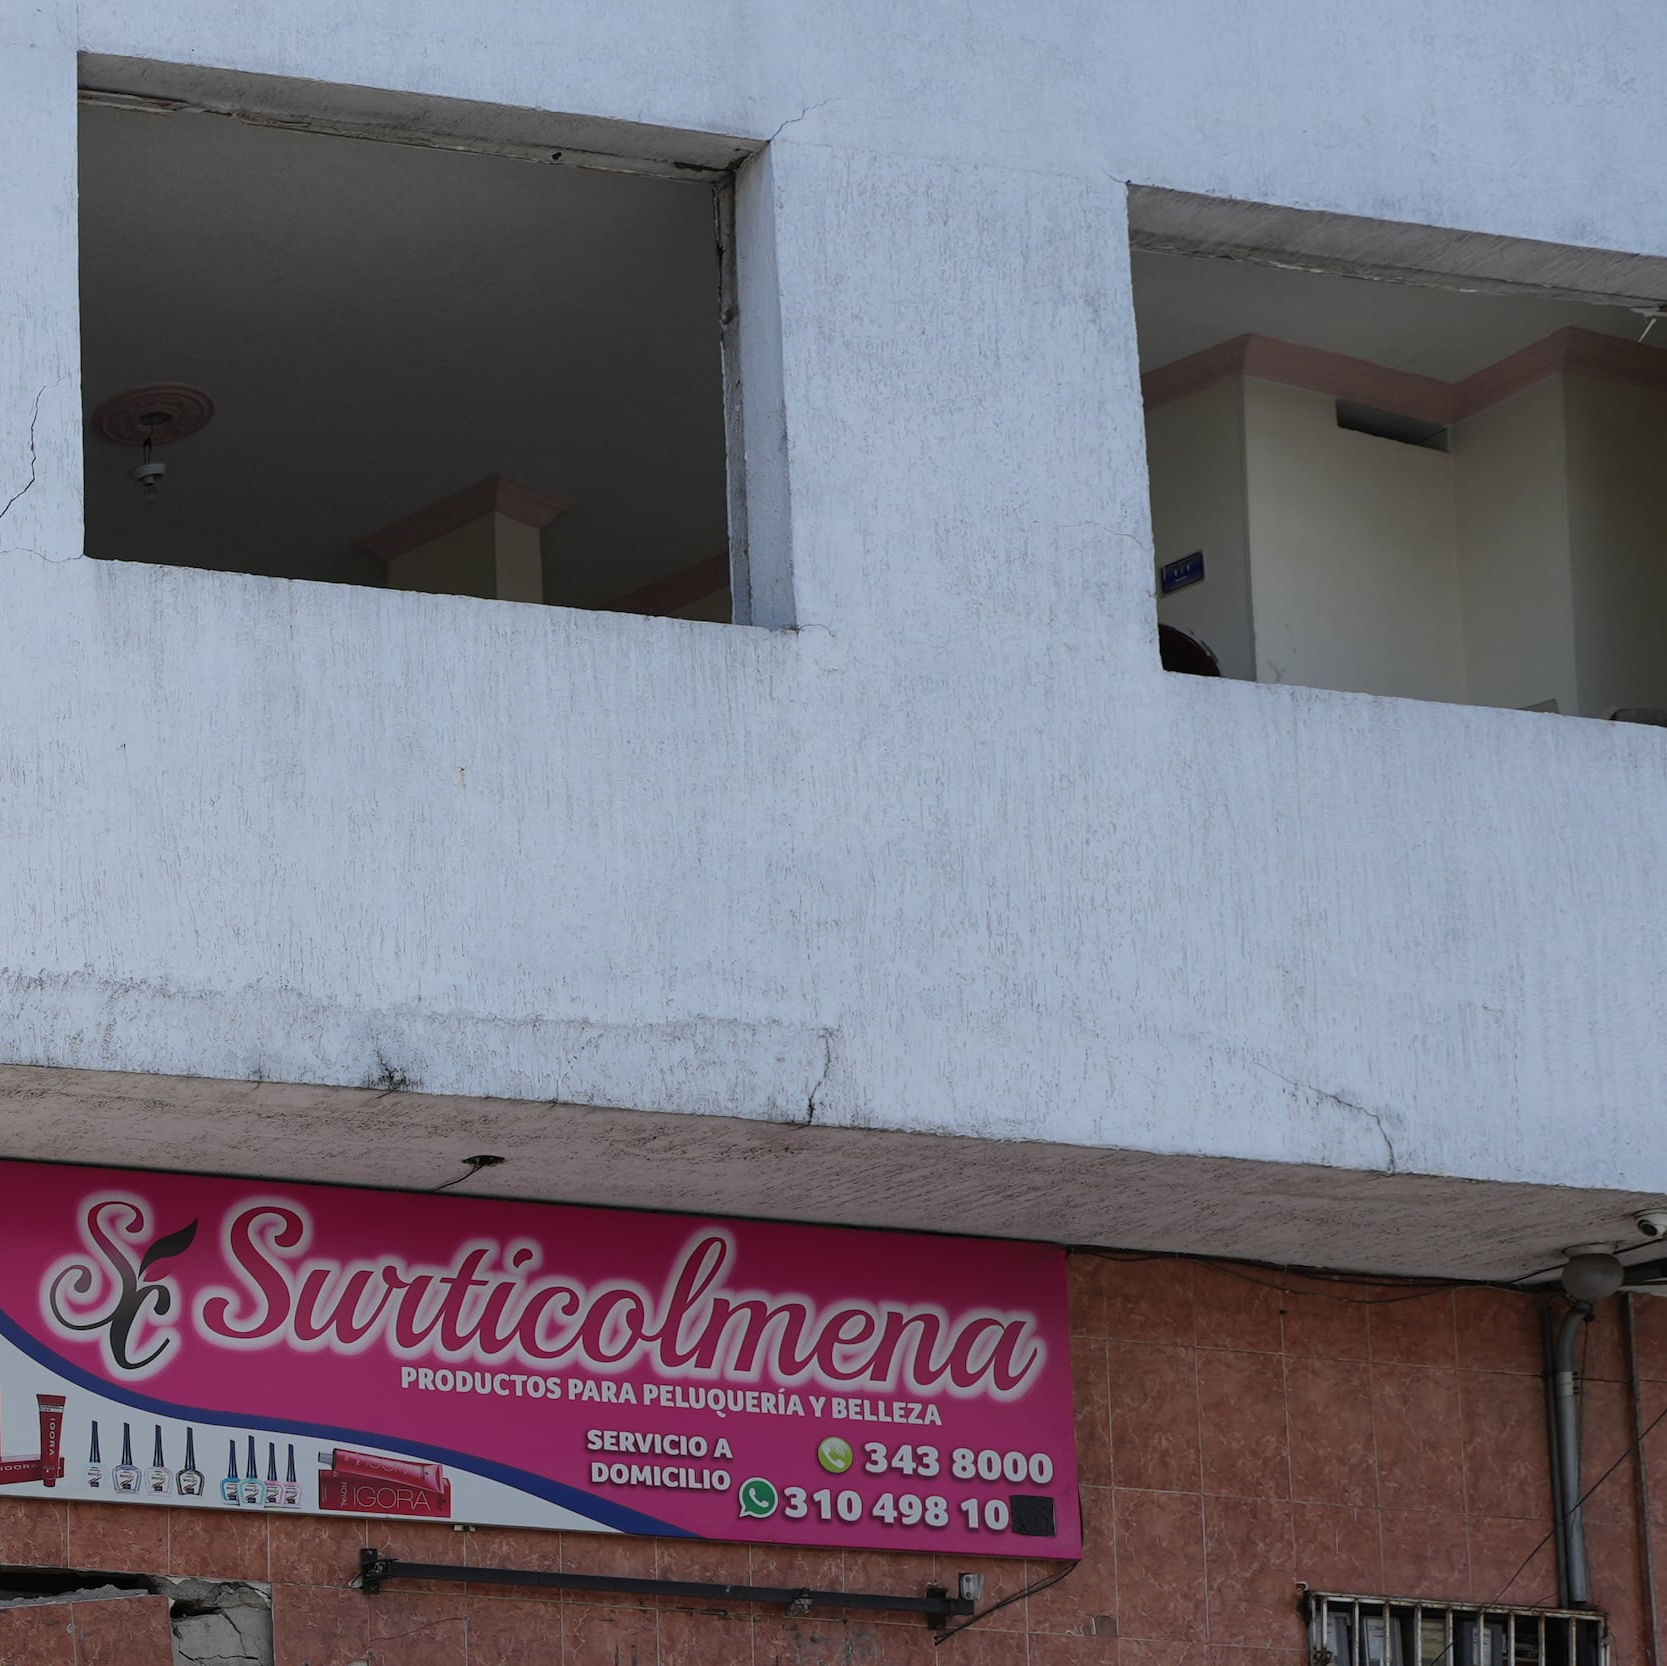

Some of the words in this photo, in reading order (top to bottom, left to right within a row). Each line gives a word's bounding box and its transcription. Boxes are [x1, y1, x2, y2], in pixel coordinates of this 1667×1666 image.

[201, 1204, 1039, 1393] Surticolmena
[400, 1365, 562, 1401] PRODUCTOS
[566, 1379, 635, 1406] PARA
[642, 1385, 806, 1419] PELUQUERÍA
[807, 1395, 826, 1418] Y
[831, 1396, 943, 1427] BELLEZA
[585, 1428, 708, 1458] SERVICIO
[713, 1435, 734, 1460] A
[863, 1441, 941, 1477] 343
[950, 1446, 1055, 1486] 8000
[589, 1460, 732, 1491] DOMICILIO
[351, 1484, 432, 1513] IGORA
[783, 1486, 863, 1524] 310
[871, 1491, 950, 1529] 498
